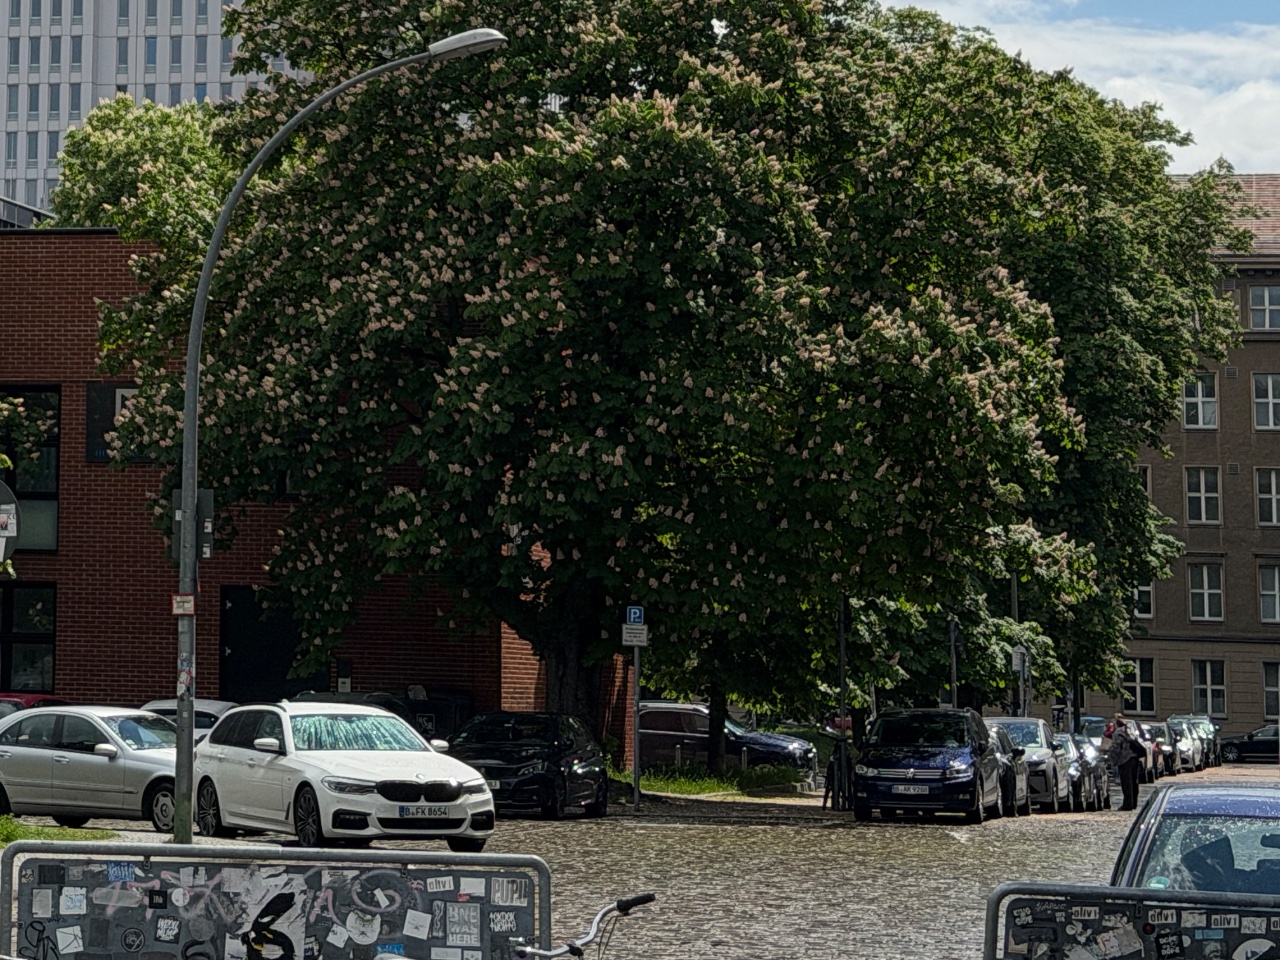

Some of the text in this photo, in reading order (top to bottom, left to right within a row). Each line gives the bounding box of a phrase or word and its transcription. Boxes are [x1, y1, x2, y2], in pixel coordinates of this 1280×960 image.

[428, 807, 448, 816] 8654
[449, 906, 478, 922] BNE
[451, 924, 477, 933] WAS
[449, 934, 478, 944] HERE
